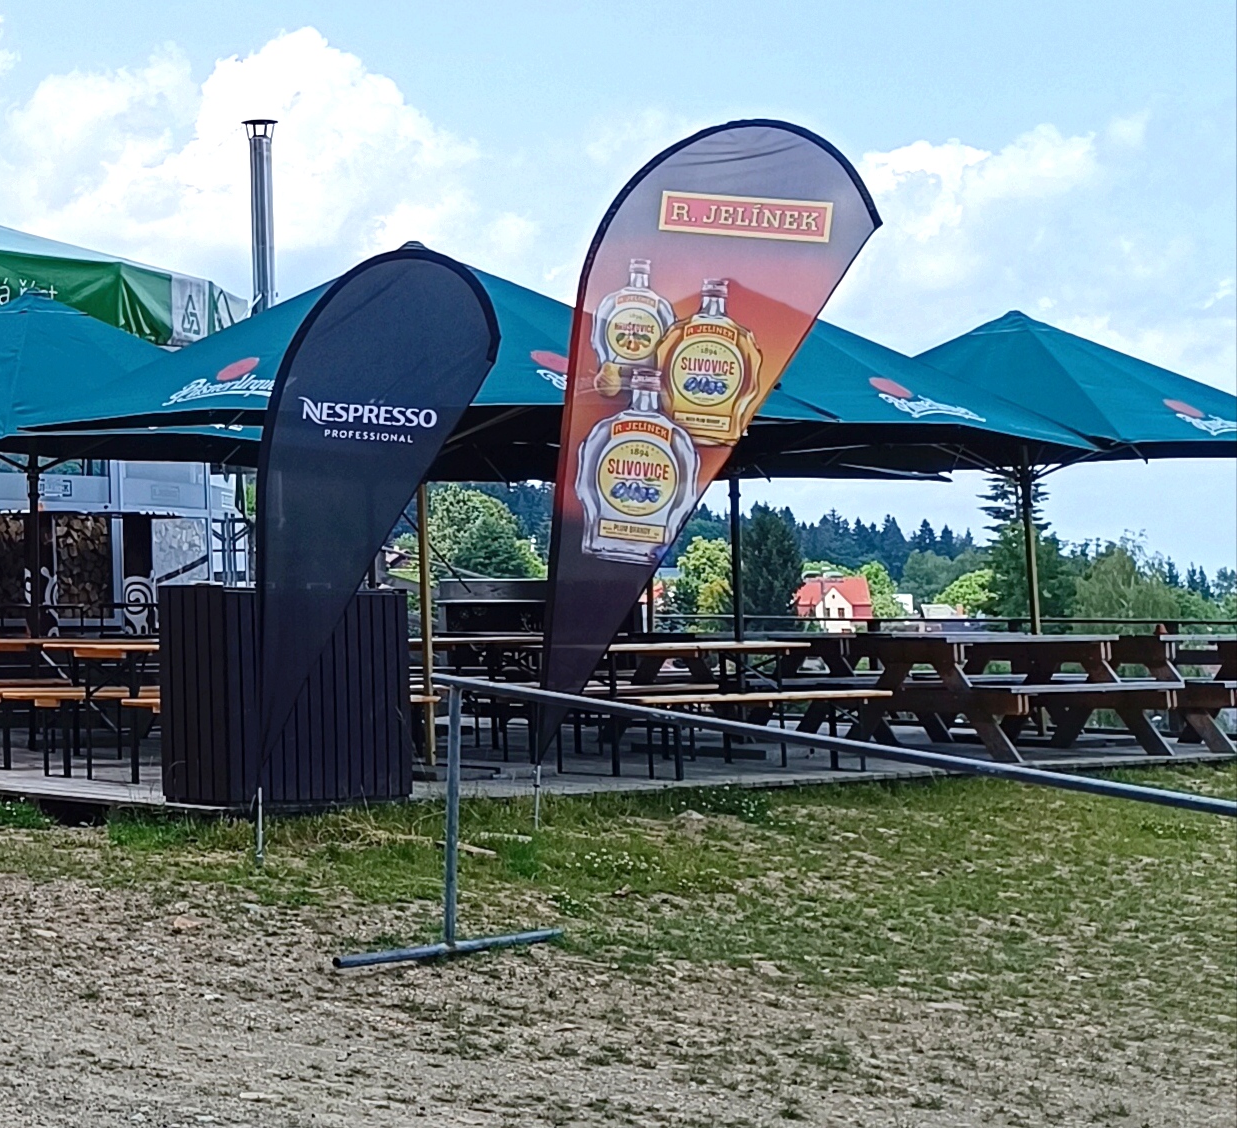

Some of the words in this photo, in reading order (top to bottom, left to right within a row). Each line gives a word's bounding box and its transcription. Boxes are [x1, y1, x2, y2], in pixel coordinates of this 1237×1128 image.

[671, 202, 696, 222] R.
[703, 204, 820, 231] JELÍNEK
[680, 356, 736, 376] SLIVOVICE
[298, 397, 437, 428] NESPRESSO
[324, 429, 414, 444] PROFESSIONAL
[607, 458, 670, 481] SLIVOVICE
